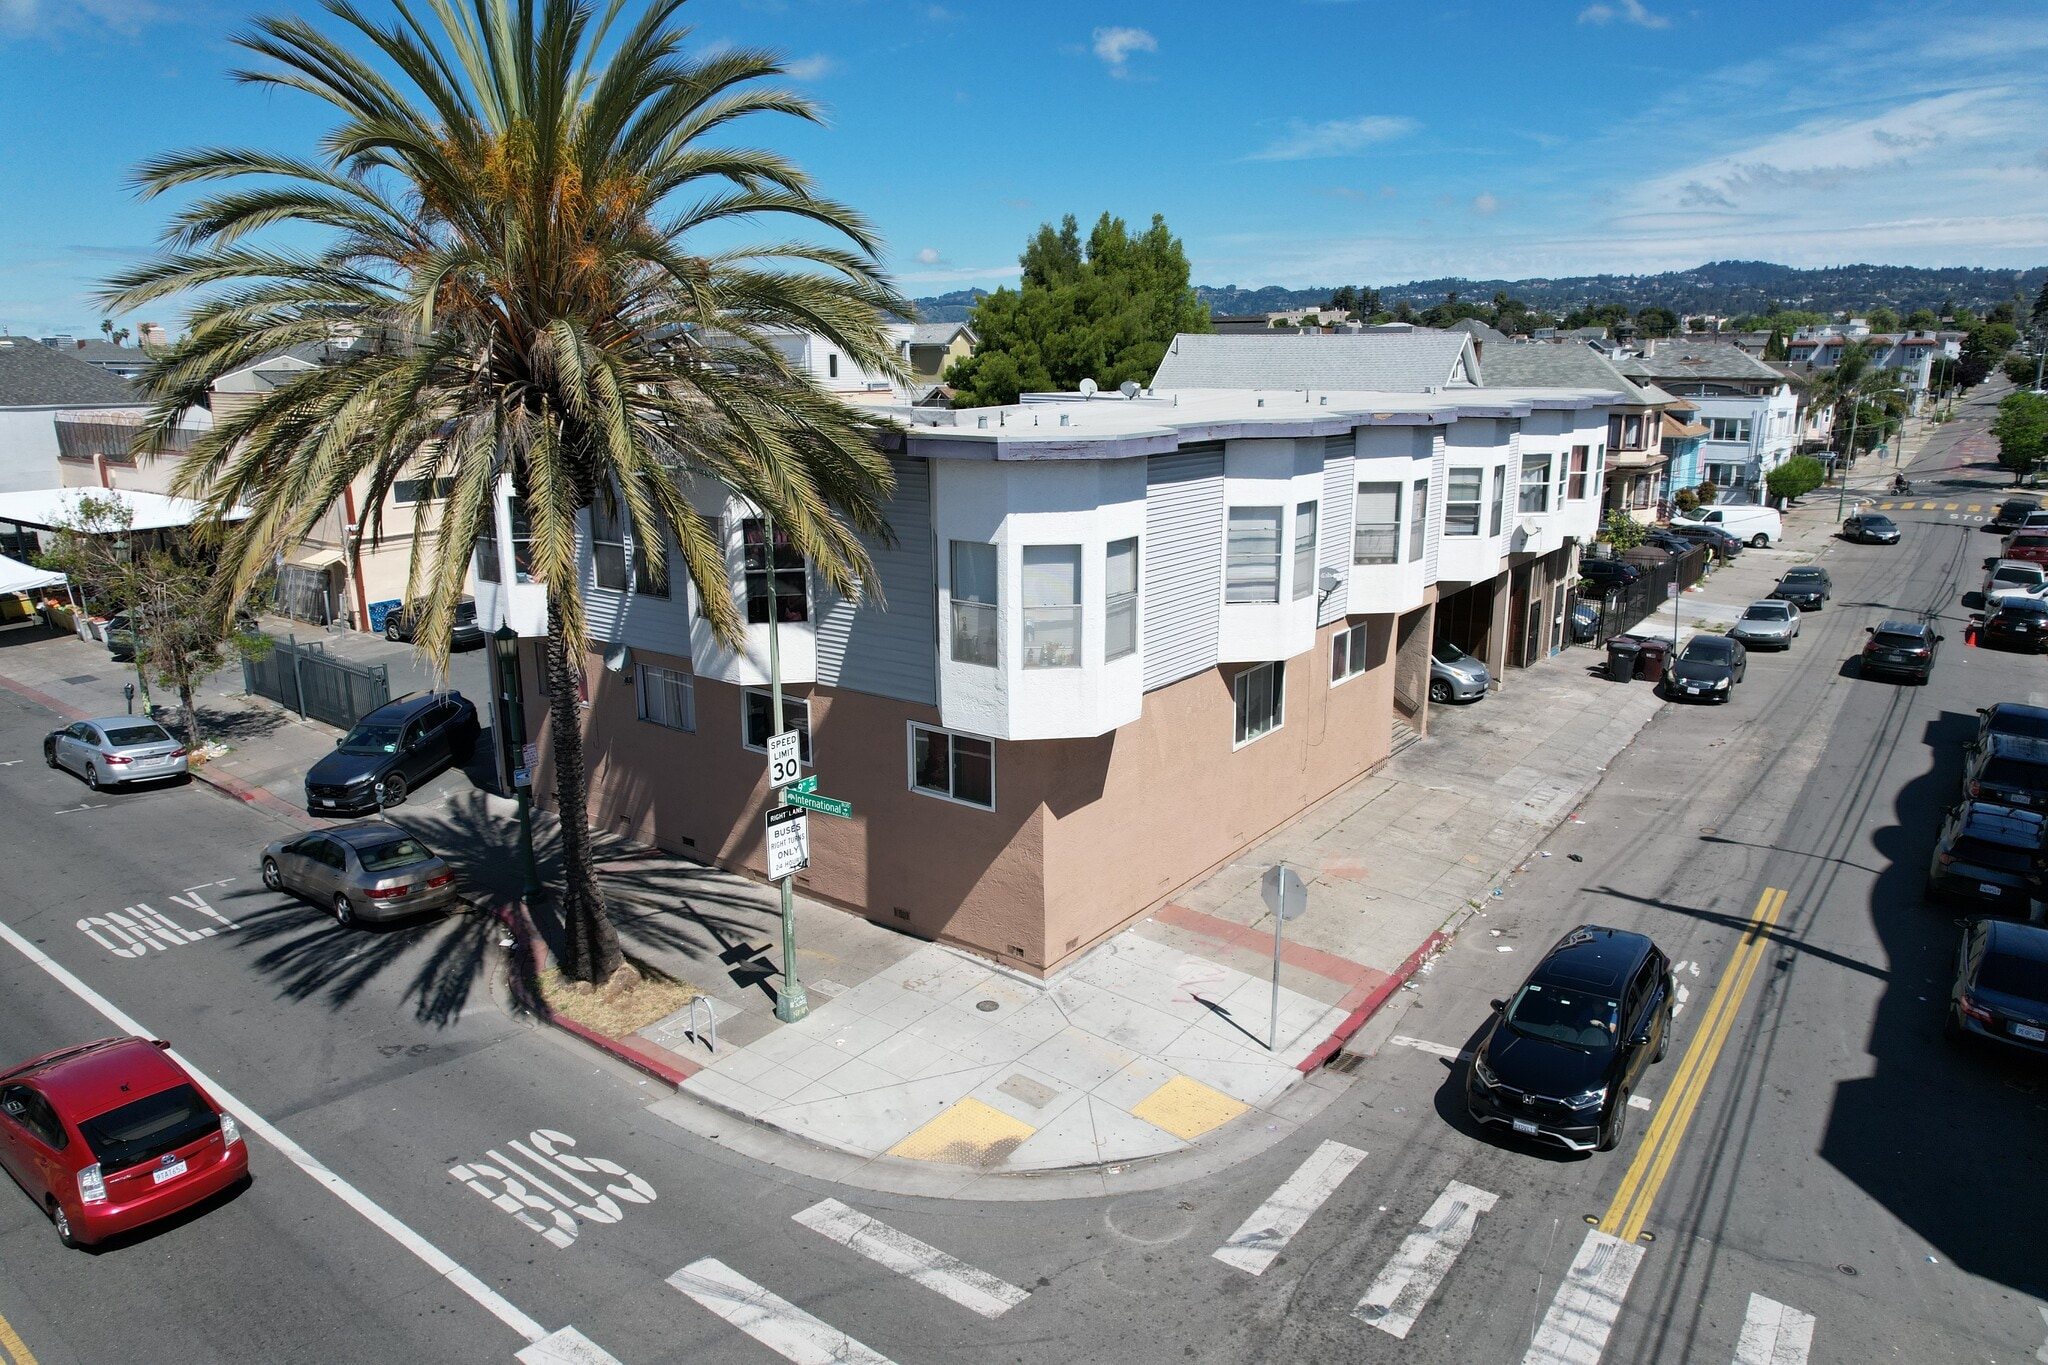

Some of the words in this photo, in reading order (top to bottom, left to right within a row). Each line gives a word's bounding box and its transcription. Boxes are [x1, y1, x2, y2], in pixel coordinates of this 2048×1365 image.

[771, 735, 797, 749] SPEED
[774, 747, 793, 760] LIMIT
[773, 758, 797, 781] 30
[795, 794, 842, 814] International
[770, 811, 787, 823] RIGHT
[788, 807, 804, 818] LANE
[774, 823, 801, 838] BUSES
[771, 839, 787, 850] RIGHT
[787, 834, 805, 846] TURNS
[778, 846, 799, 859] ONLY
[75, 891, 241, 959] ONLY
[448, 1129, 657, 1249] BUS
